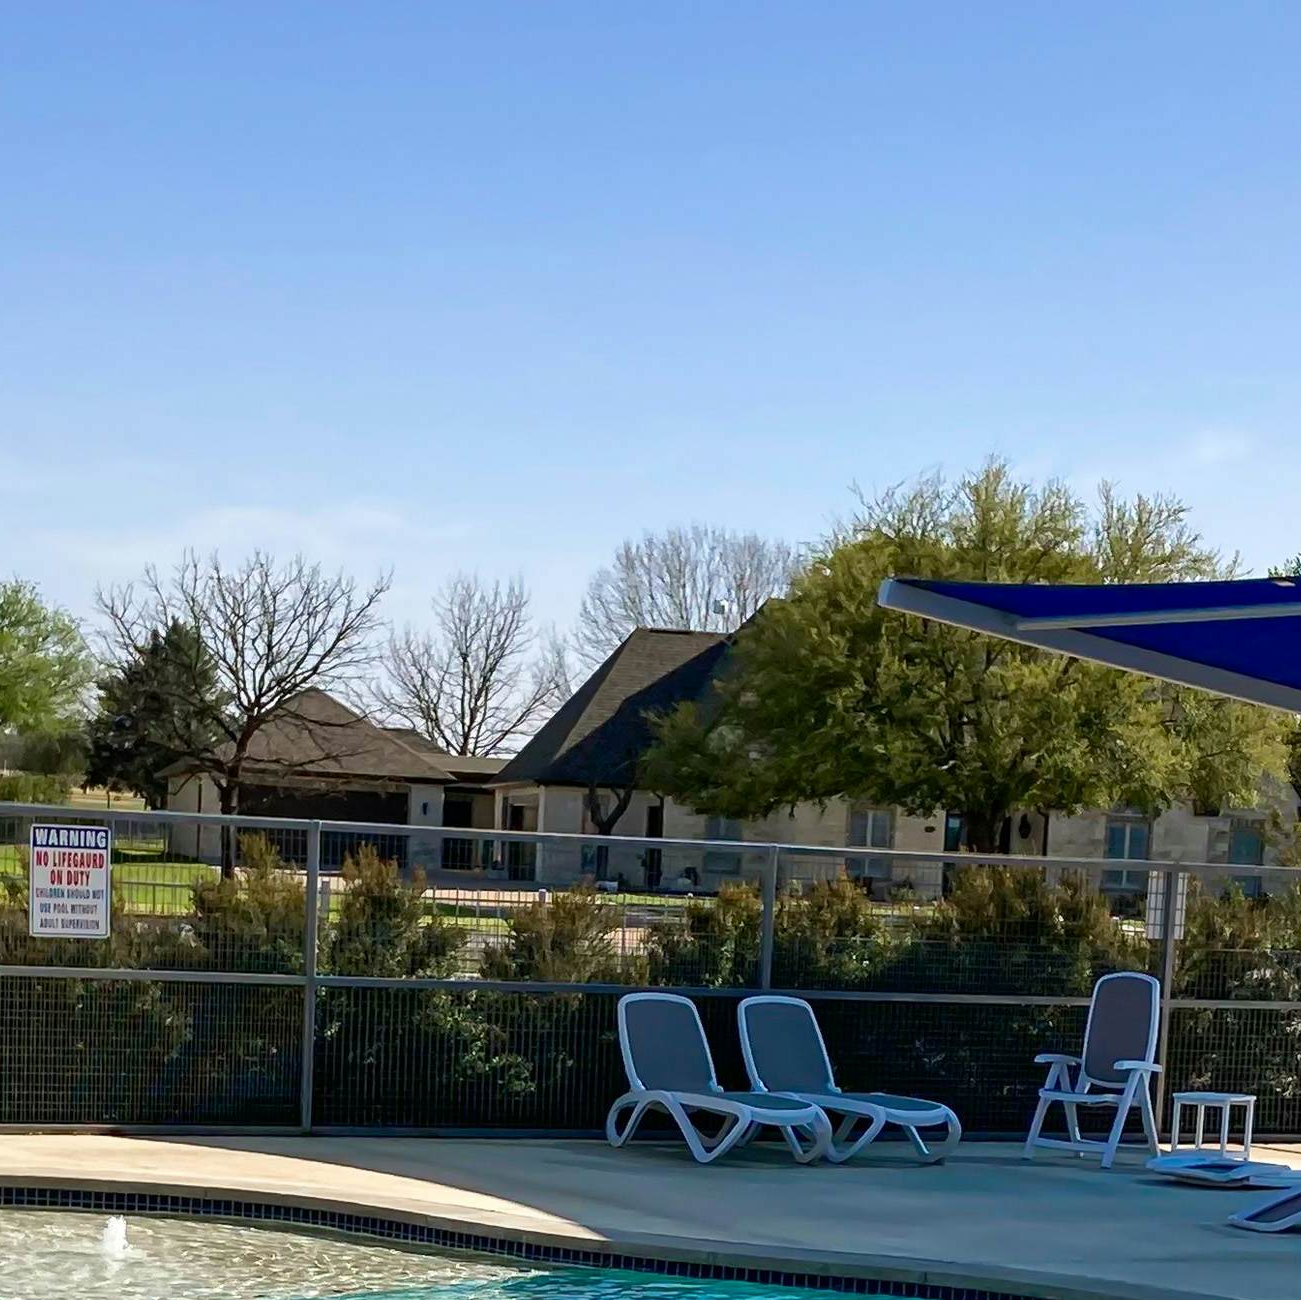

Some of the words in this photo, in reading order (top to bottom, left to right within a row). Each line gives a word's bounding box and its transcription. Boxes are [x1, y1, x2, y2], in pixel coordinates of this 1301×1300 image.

[35, 828, 107, 848] WARNING
[36, 850, 49, 868] NO
[53, 851, 105, 869] LIFEGAURD
[50, 869, 63, 885] ON
[67, 870, 91, 886] DUTY
[35, 887, 65, 899] CHILDREN
[66, 888, 91, 900] SHOULD
[92, 889, 105, 900] NOT
[40, 902, 51, 914] USE
[53, 903, 69, 914] POOL
[70, 903, 98, 915] WITHOUT
[40, 917, 59, 929] ADULT
[60, 918, 100, 930] SUPERVISION
